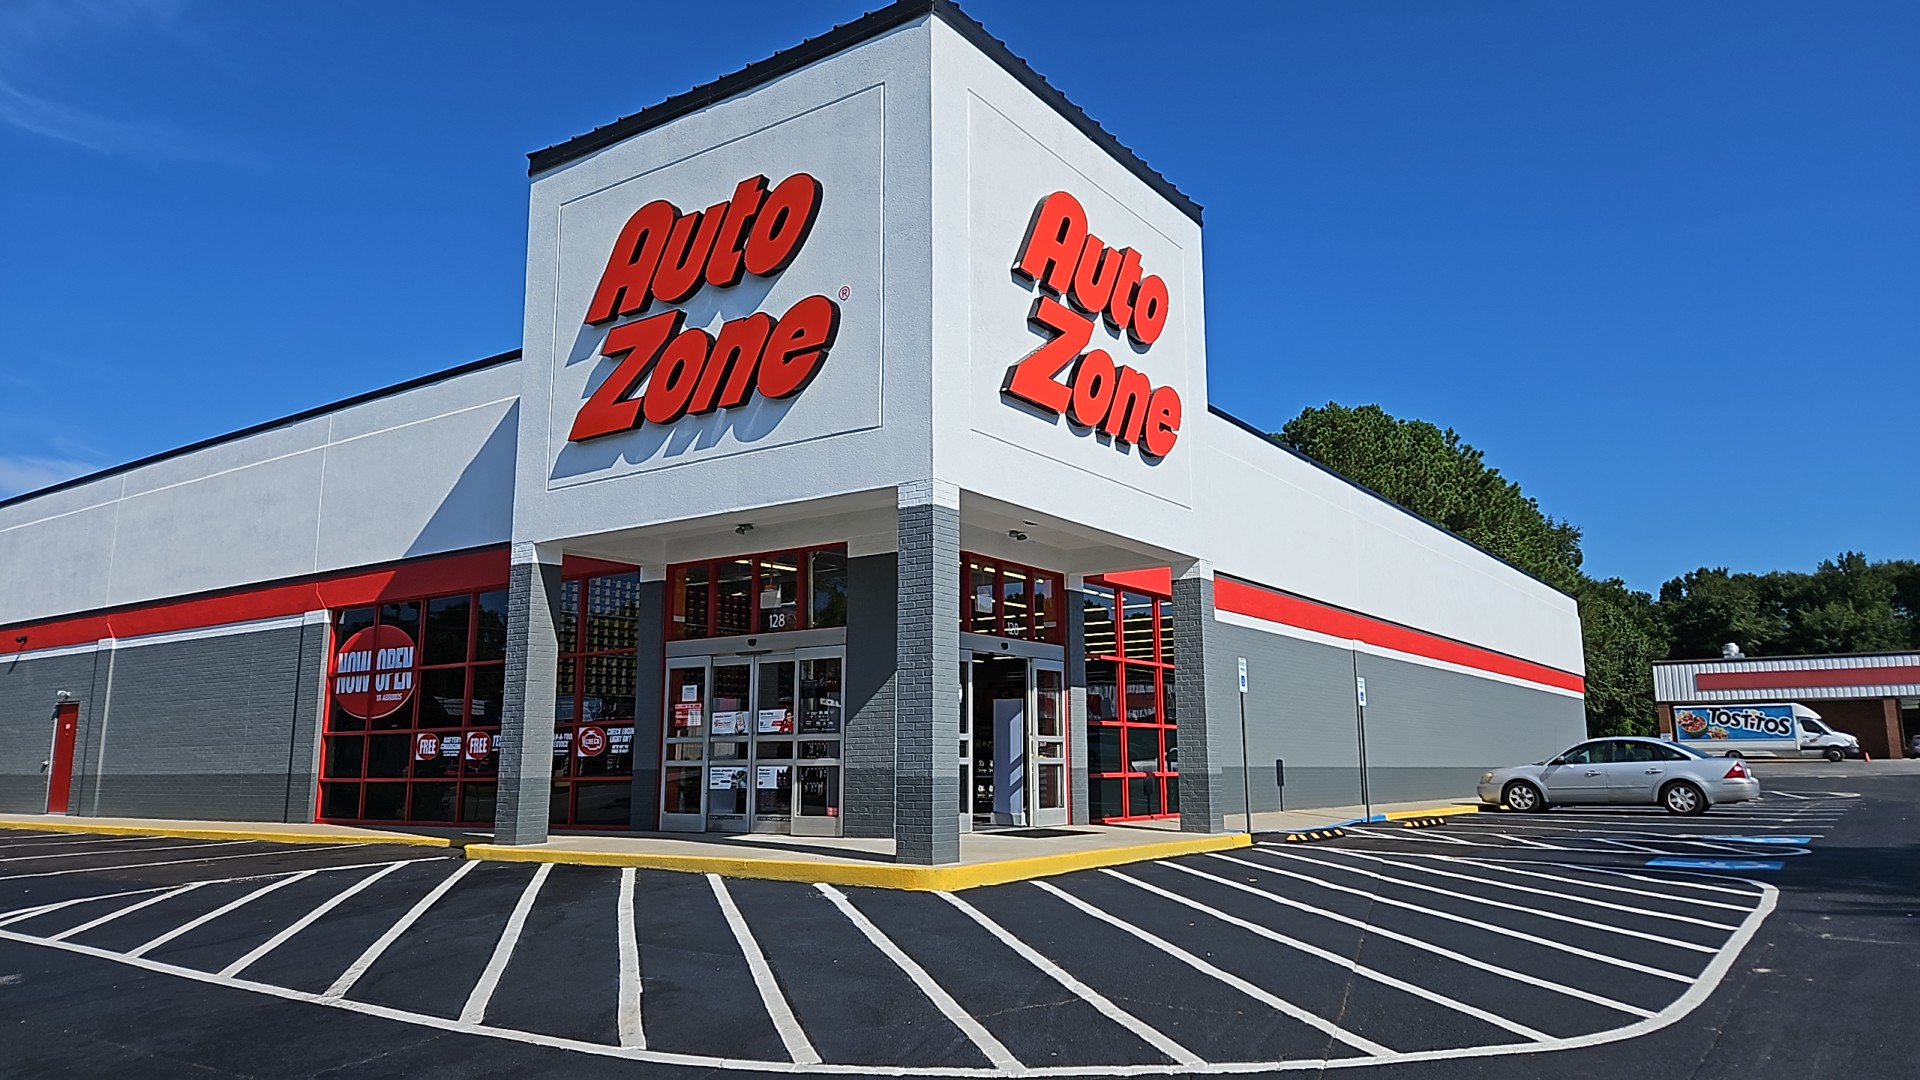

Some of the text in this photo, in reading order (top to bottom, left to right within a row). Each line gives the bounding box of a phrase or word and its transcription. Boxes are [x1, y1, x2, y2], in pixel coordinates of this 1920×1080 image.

[585, 172, 823, 327] Auto
[1011, 190, 1169, 350] Auto
[568, 294, 841, 442] Zone
[1000, 296, 1182, 462] Zone
[769, 613, 785, 629] 128
[336, 646, 414, 694] NOW OPEN
[469, 737, 488, 753] FREE
[1708, 707, 1792, 736] TOSTITOS
[419, 739, 437, 754] FREE
